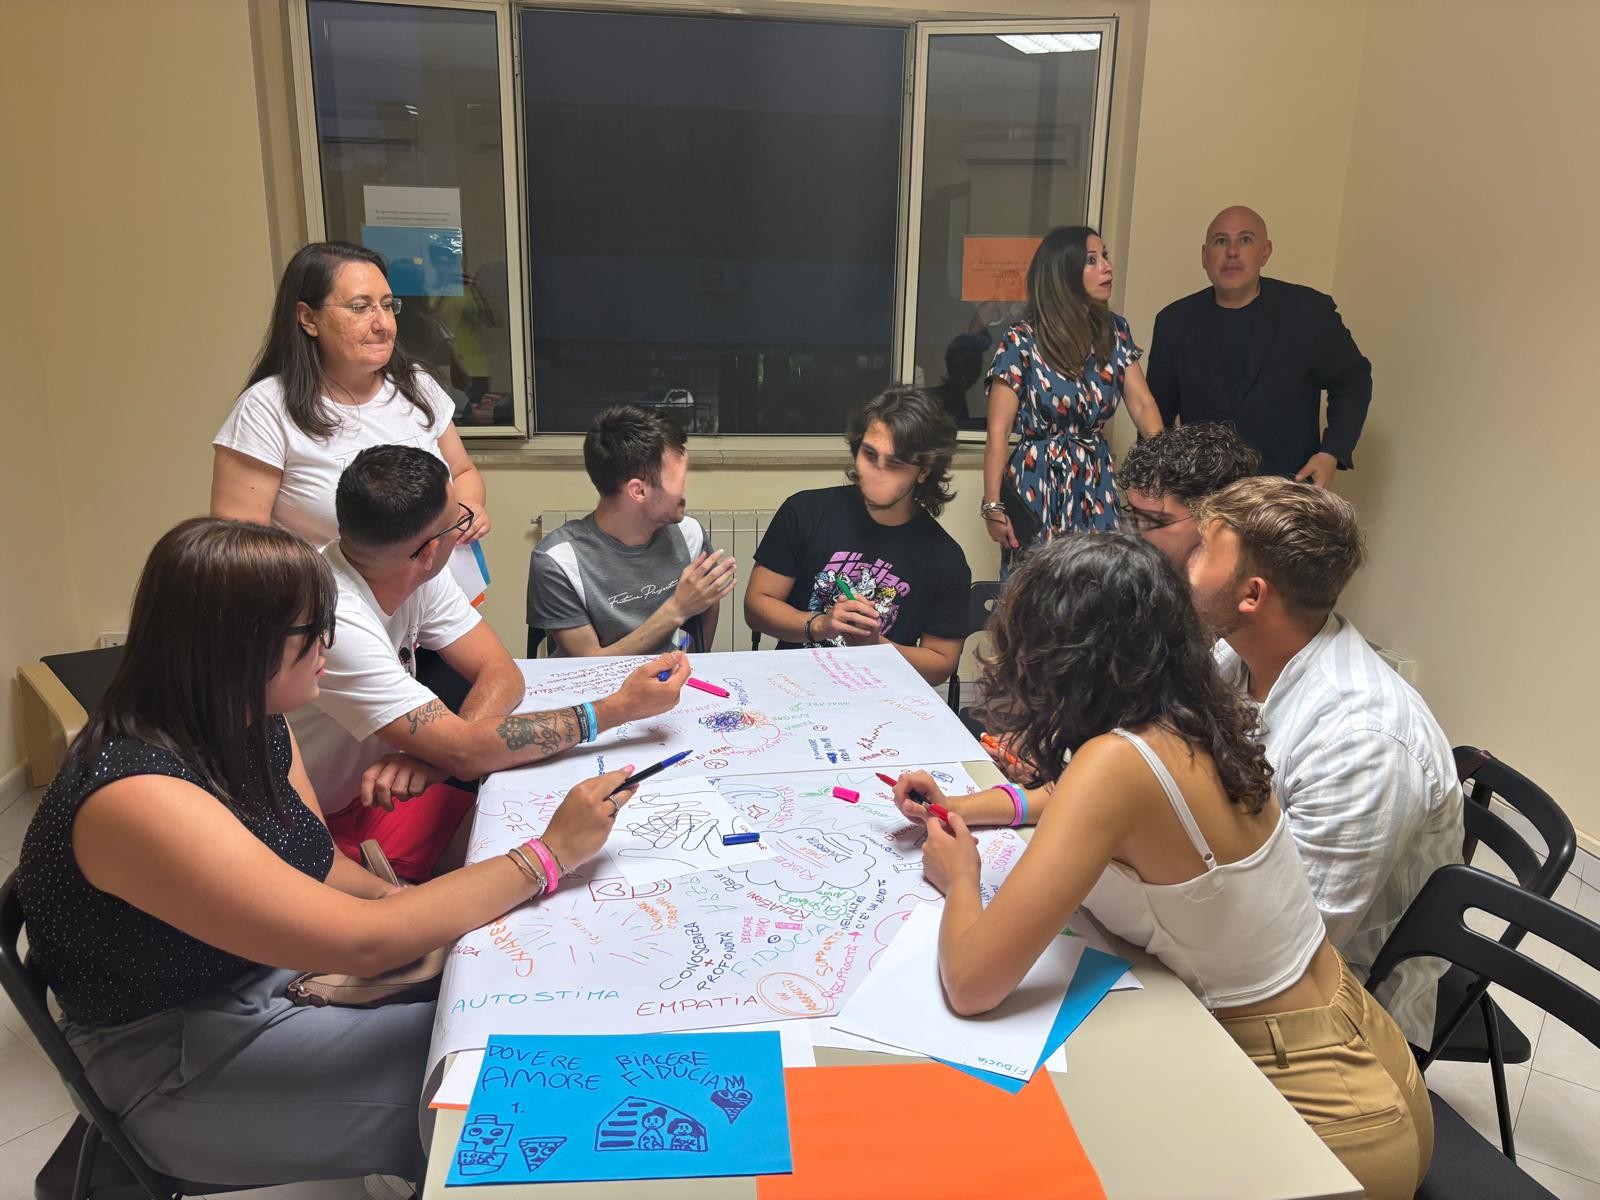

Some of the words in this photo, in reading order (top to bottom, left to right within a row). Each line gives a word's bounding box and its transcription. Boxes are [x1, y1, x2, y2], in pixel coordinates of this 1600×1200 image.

[659, 921, 710, 990] CONOSCENZA
[730, 923, 834, 979] FIDUCIA
[450, 986, 620, 1014] AUTOSTIMA
[636, 993, 758, 1017] EMPATIA
[488, 1045, 582, 1070] DOVERE
[481, 1066, 602, 1092] AMORE
[620, 1064, 720, 1090] FIDUCIA
